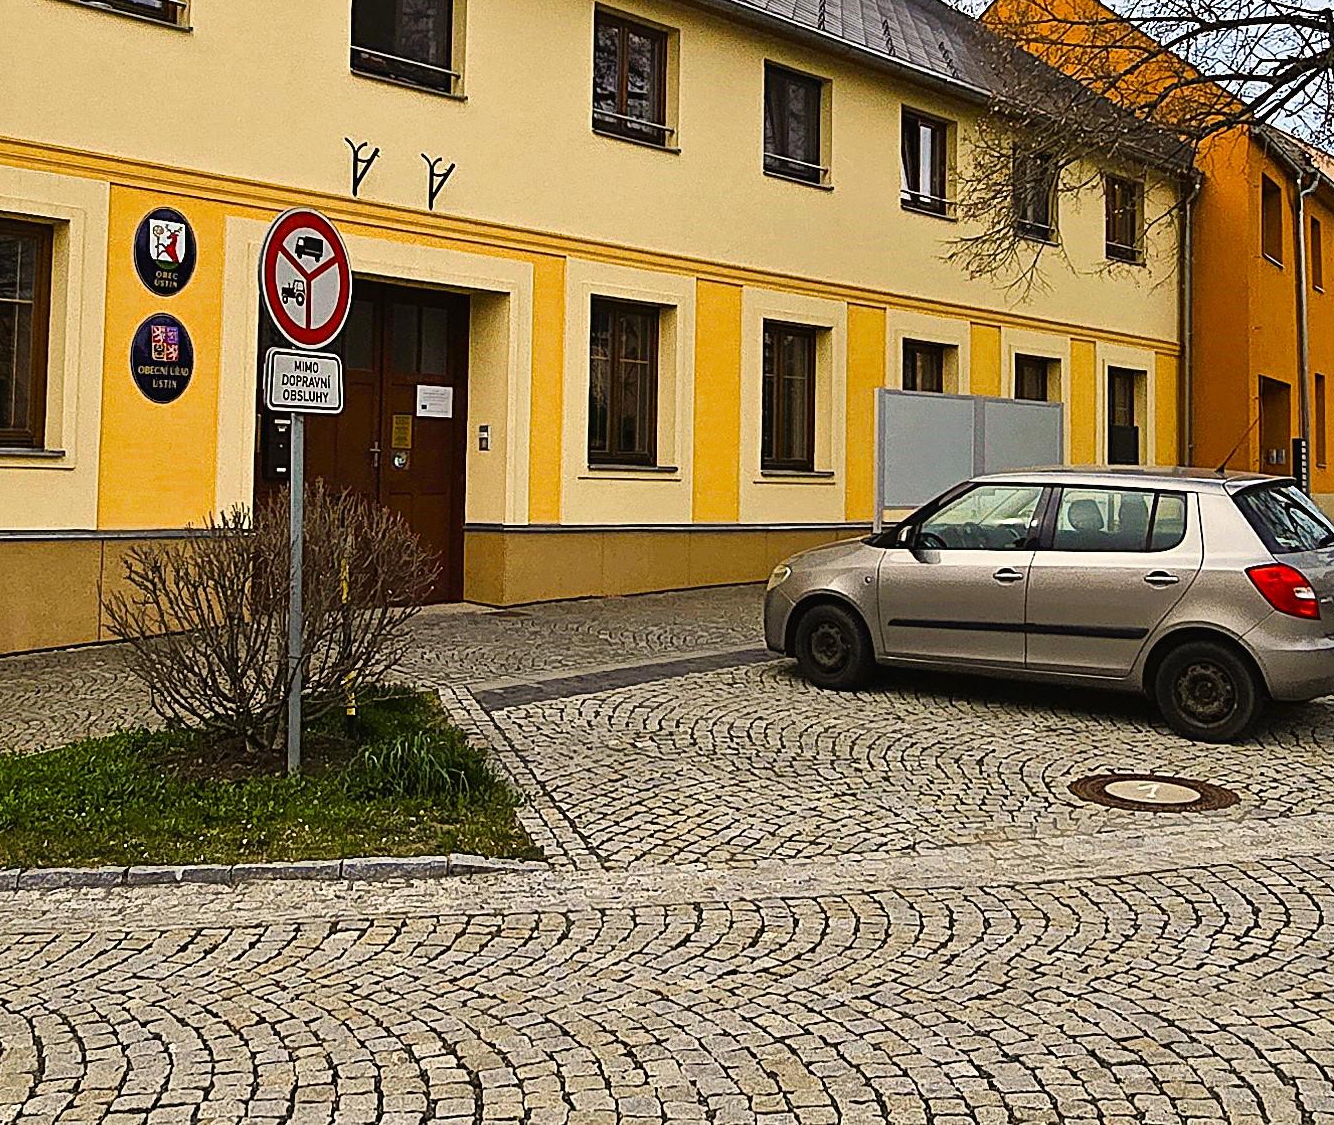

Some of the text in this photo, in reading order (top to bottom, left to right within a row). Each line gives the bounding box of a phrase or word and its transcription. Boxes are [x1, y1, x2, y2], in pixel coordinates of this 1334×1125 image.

[155, 270, 179, 280] OBEC
[294, 360, 319, 373] MIMO
[281, 373, 331, 389] DOPRAVNÍ
[282, 388, 329, 403] OBSLUHY
